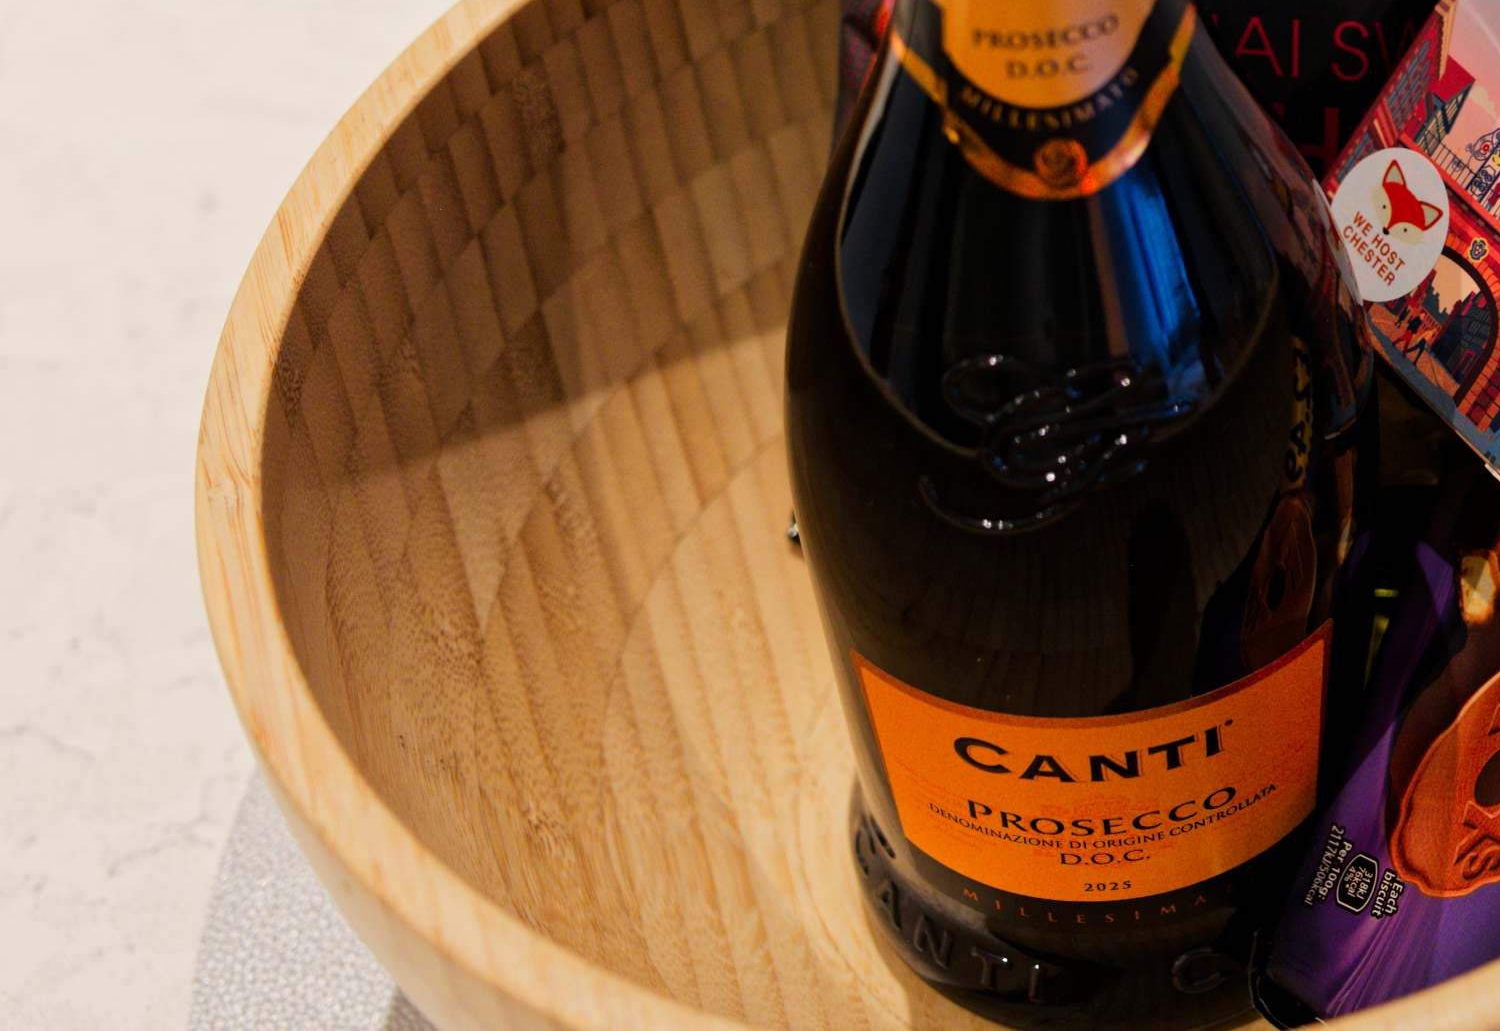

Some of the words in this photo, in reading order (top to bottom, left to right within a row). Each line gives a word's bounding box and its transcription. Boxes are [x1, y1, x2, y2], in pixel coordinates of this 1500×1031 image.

[973, 15, 1119, 47] PROSECCO
[1343, 225, 1396, 286] CHESTER
[1353, 210, 1373, 236] WE
[1372, 234, 1406, 270] HOST
[953, 725, 1226, 783] CANTI
[929, 802, 1064, 849] DENOMINAZIONE
[1070, 838, 1087, 849] DI
[1092, 831, 1165, 849] ORIGINE
[1169, 784, 1278, 838] CONTROLLATA
[967, 786, 1236, 837] PROSECCO
[1060, 849, 1151, 866] D.O.C.
[1304, 825, 1344, 905] 2117kJ/506kcal
[1337, 841, 1352, 863] Per
[1084, 880, 1132, 892] 2025
[1318, 868, 1340, 900] 100g:
[1347, 867, 1366, 897] 76kcal
[1357, 871, 1373, 900] 318kJ
[1372, 871, 1395, 917] biscuit
[1384, 881, 1403, 914] Each
